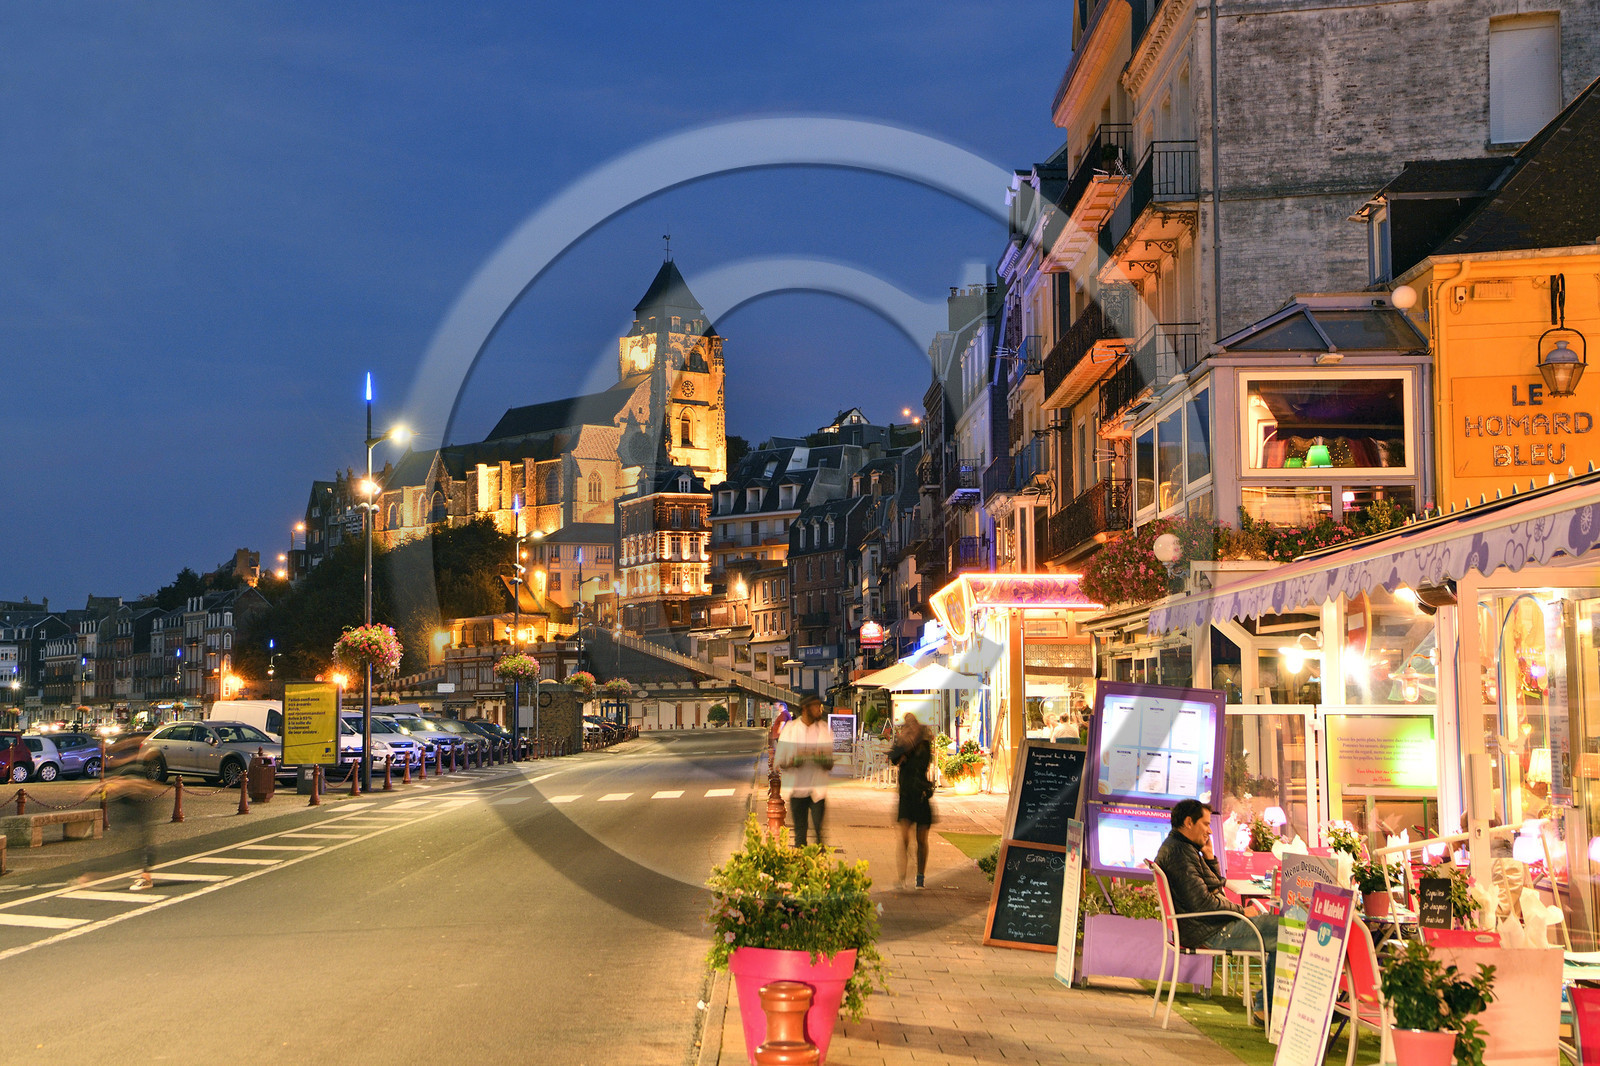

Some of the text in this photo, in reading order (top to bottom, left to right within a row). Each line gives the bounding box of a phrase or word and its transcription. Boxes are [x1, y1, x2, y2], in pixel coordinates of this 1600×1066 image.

[1511, 383, 1543, 406] LE
[1465, 412, 1593, 437] HOMARD
[1493, 443, 1566, 467] BLEU
[1284, 864, 1300, 880] Menu
[1287, 890, 1295, 906] St
[1314, 897, 1322, 914] Le
[1322, 899, 1345, 920] Matelot
